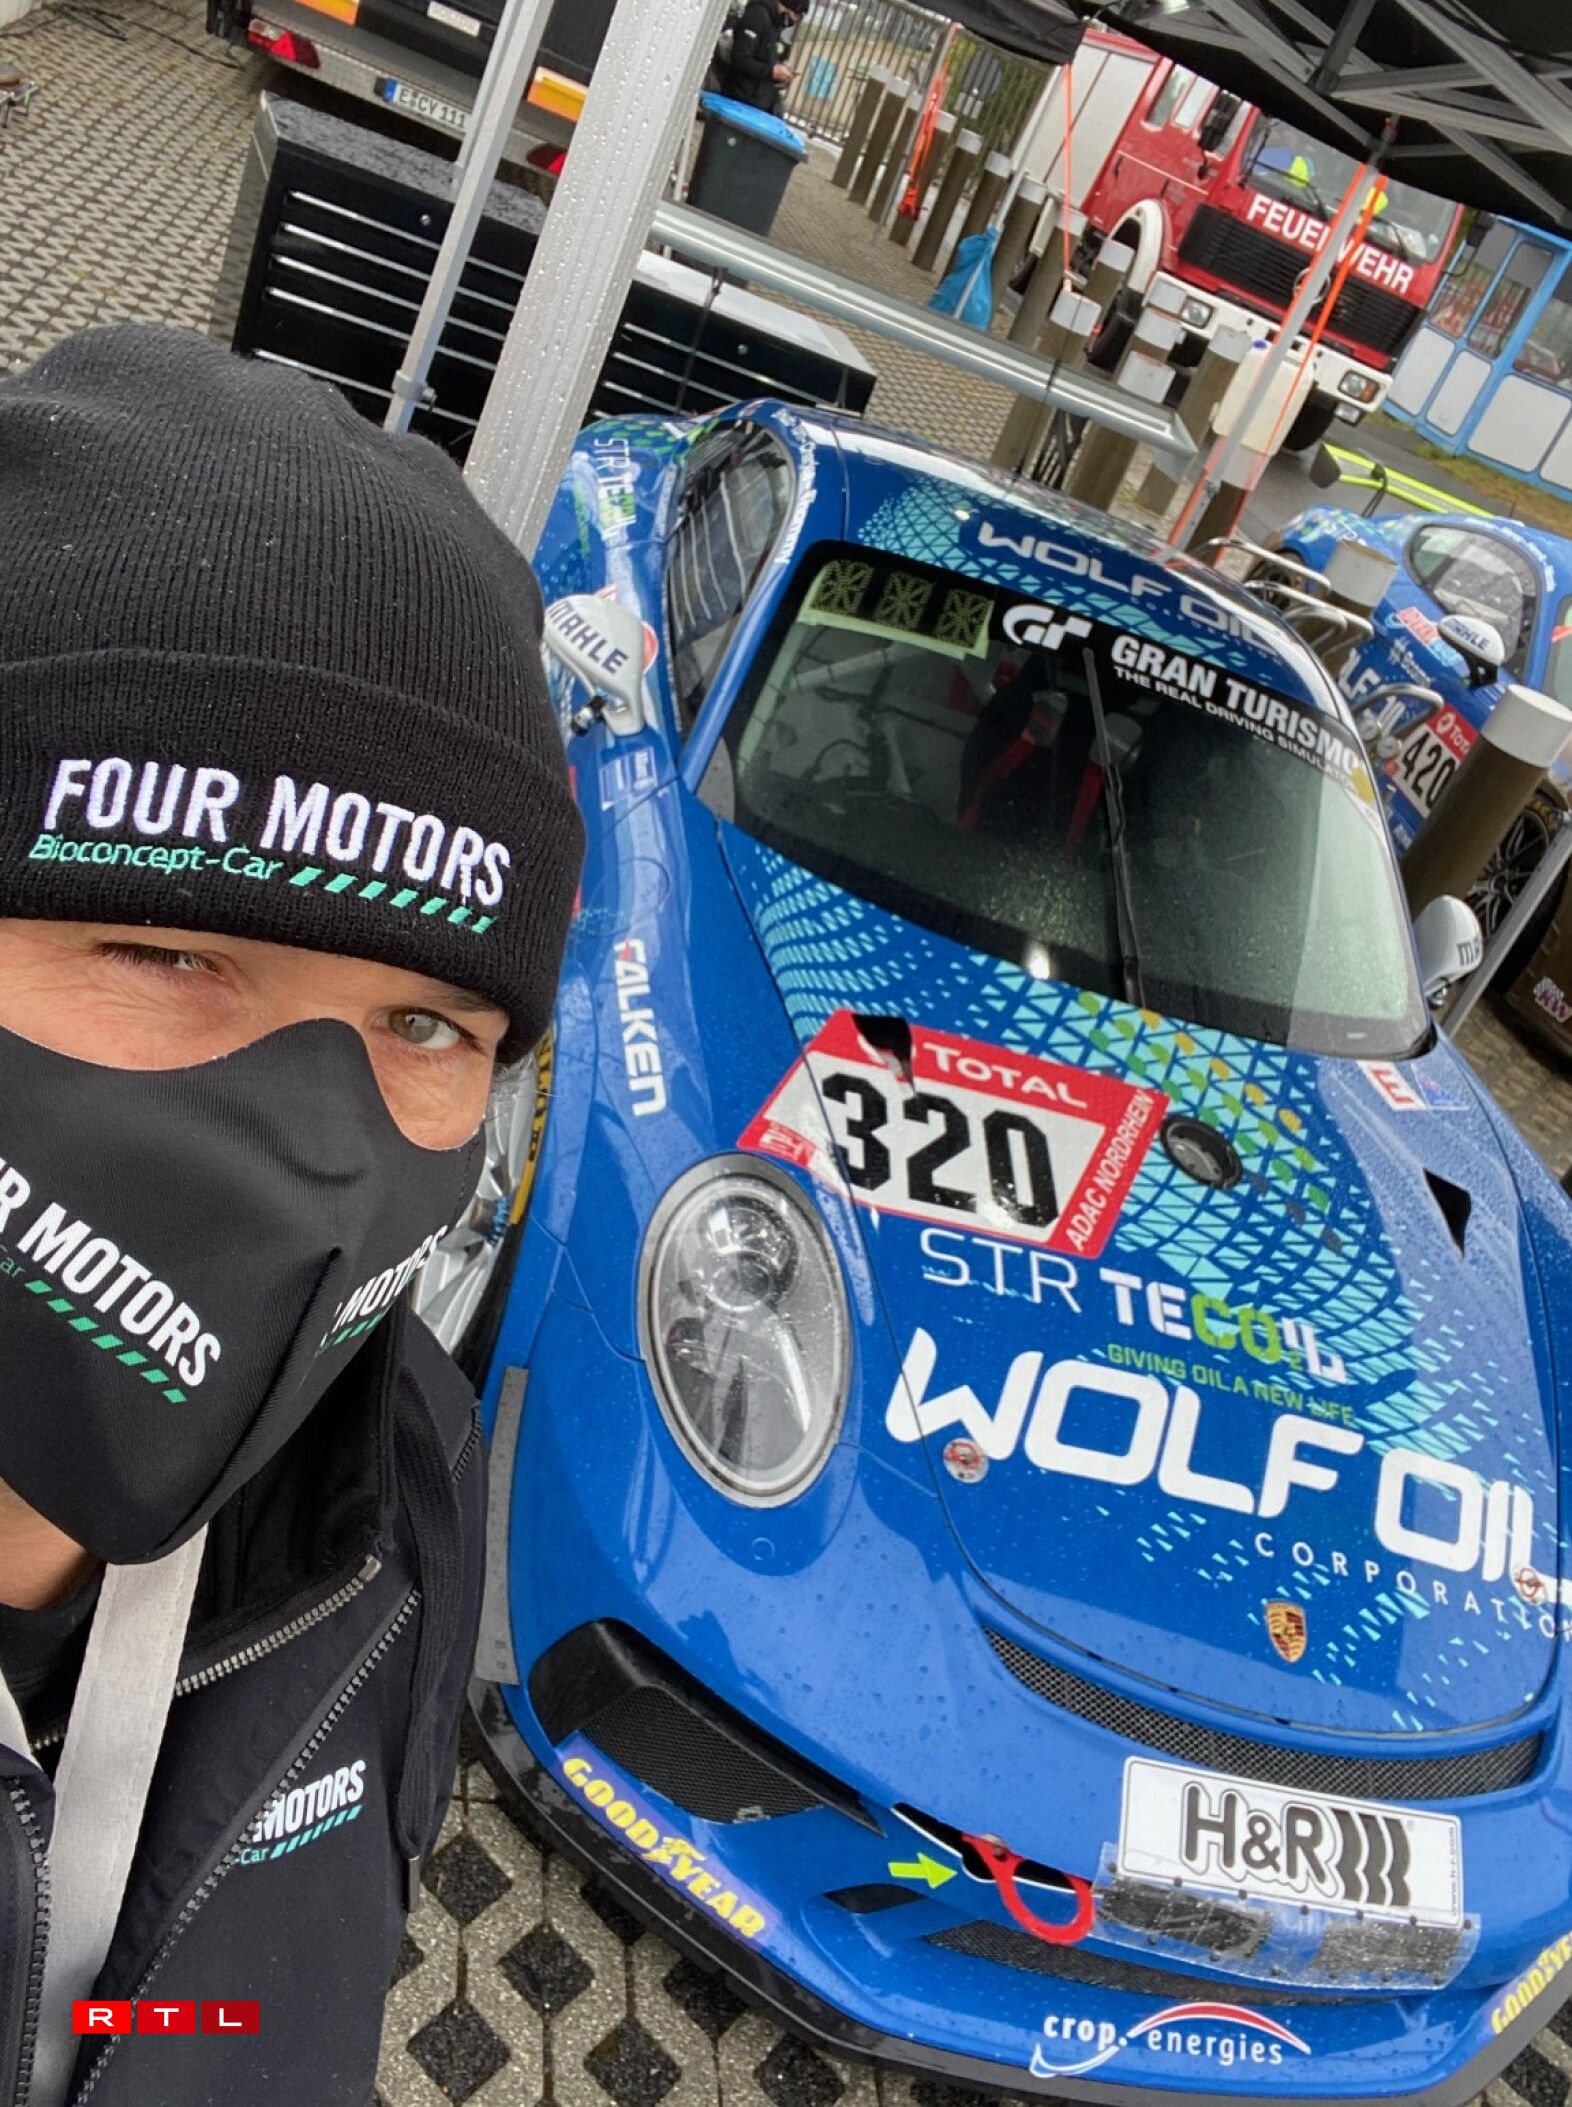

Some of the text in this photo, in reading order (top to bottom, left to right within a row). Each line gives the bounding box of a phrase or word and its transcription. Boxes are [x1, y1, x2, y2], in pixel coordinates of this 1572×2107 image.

[977, 521, 1172, 598] WOLF
[1111, 634, 1360, 776] GRAN TURISMO
[1113, 665, 1151, 689] THE
[1156, 680, 1203, 710] REAL
[1205, 702, 1274, 745] DRIVING
[1402, 731, 1456, 810] 420
[28, 833, 285, 880] Bioconcept-Car
[44, 756, 240, 842] FOUR
[260, 773, 511, 907] MOTORS
[922, 1041, 1089, 1110] TOTAL
[821, 1072, 1060, 1229] 320
[1064, 1088, 1155, 1251] ADAC NORDRHEIN
[17, 1202, 221, 1387] MOTORS
[920, 1226, 1083, 1313] STR
[1106, 1344, 1356, 1425] GIVING OIL A NEW LIFE
[884, 1327, 1572, 1607] WOLF OIL
[562, 1758, 766, 1938] GOODYEAR
[1182, 1783, 1330, 1889] H&R
[1147, 2028, 1283, 2066] energies
